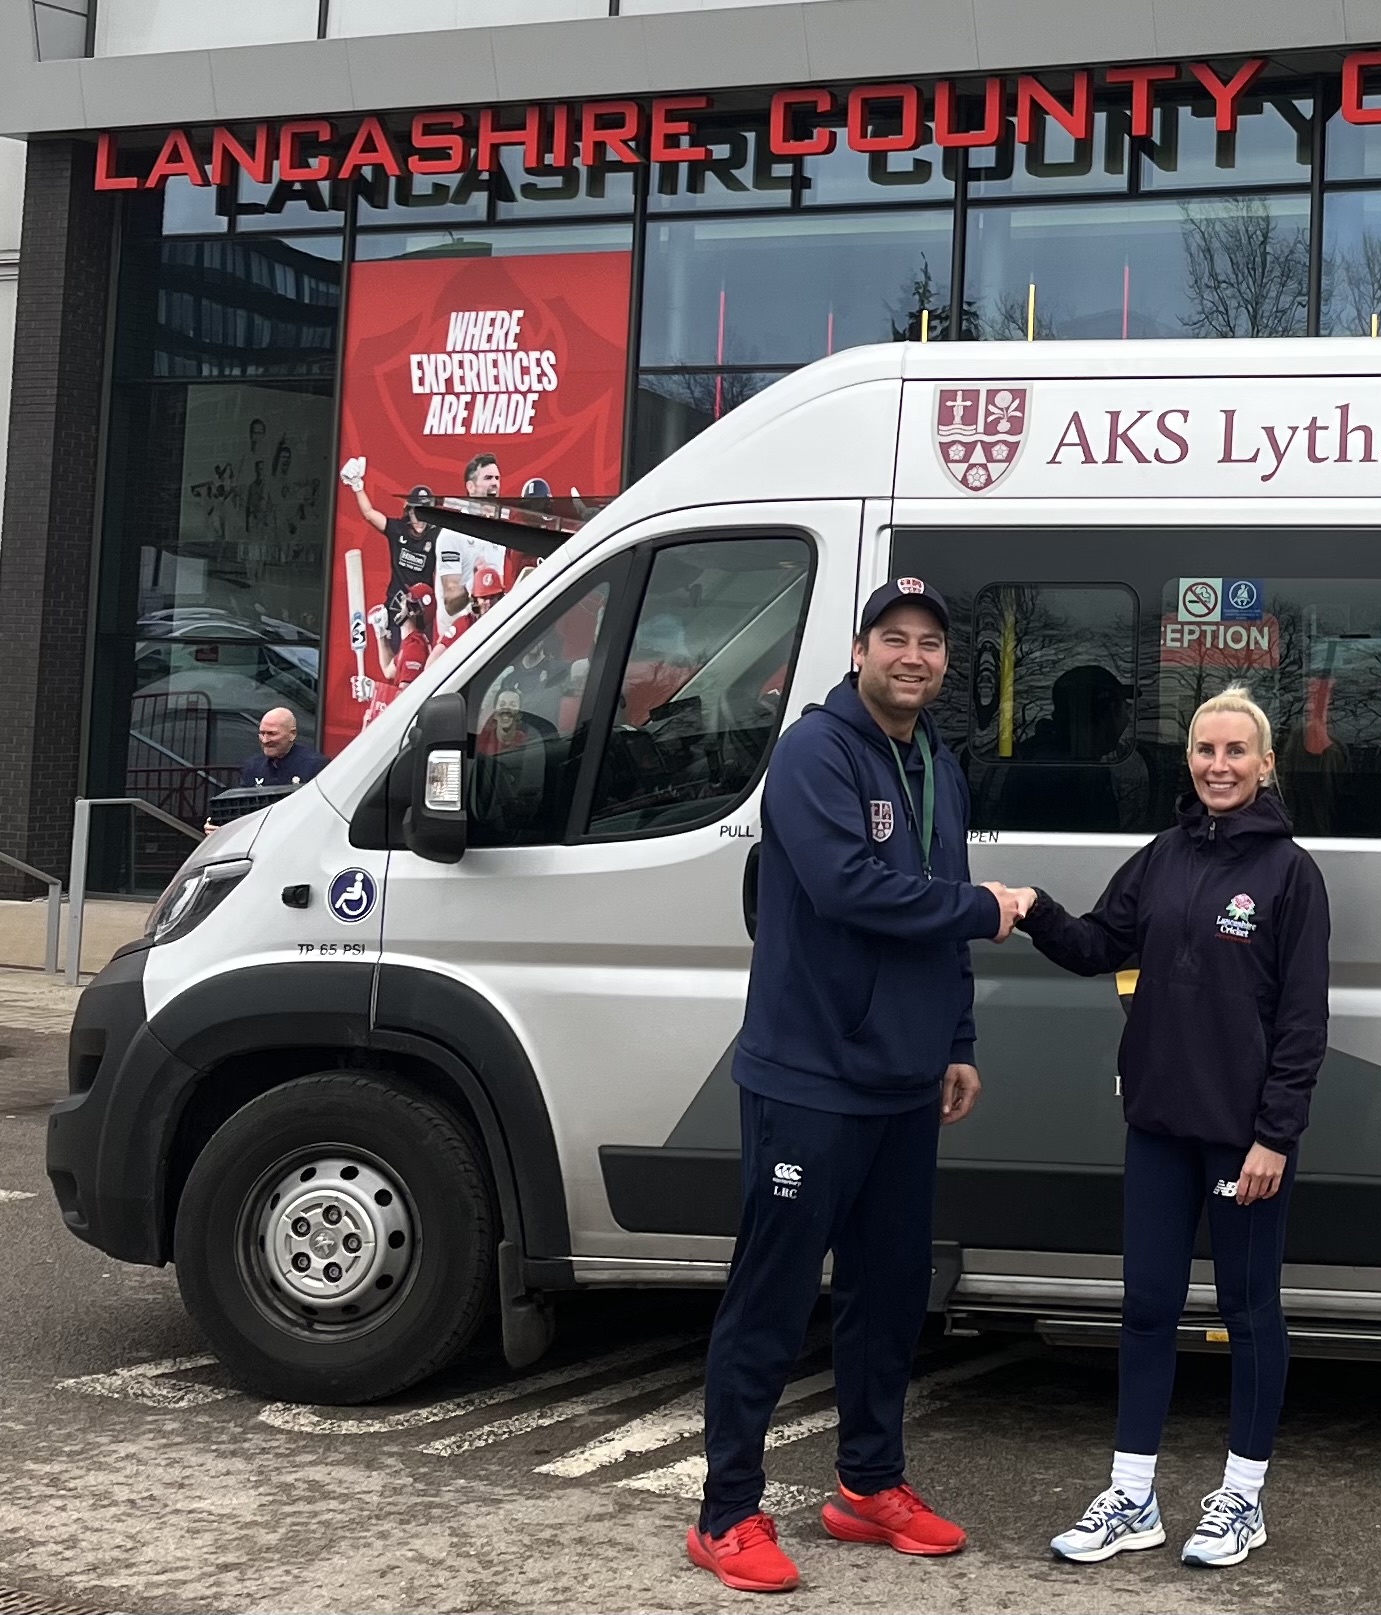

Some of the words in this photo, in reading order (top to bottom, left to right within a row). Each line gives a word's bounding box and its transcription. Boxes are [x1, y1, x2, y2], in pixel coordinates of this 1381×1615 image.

[95, 95, 714, 191] LANCASHIRE
[770, 58, 1267, 155] COUNTY
[445, 310, 525, 352] WHERE
[410, 350, 558, 394] EXPERIENCES
[423, 394, 472, 435] ARE
[470, 392, 540, 434] MADE
[1047, 409, 1189, 465] AKS
[1160, 624, 1269, 651] EPTION
[720, 825, 755, 838] PULL
[966, 830, 999, 844] PEN
[297, 943, 315, 956] TP
[319, 943, 337, 956] 65
[342, 943, 366, 956] PSI
